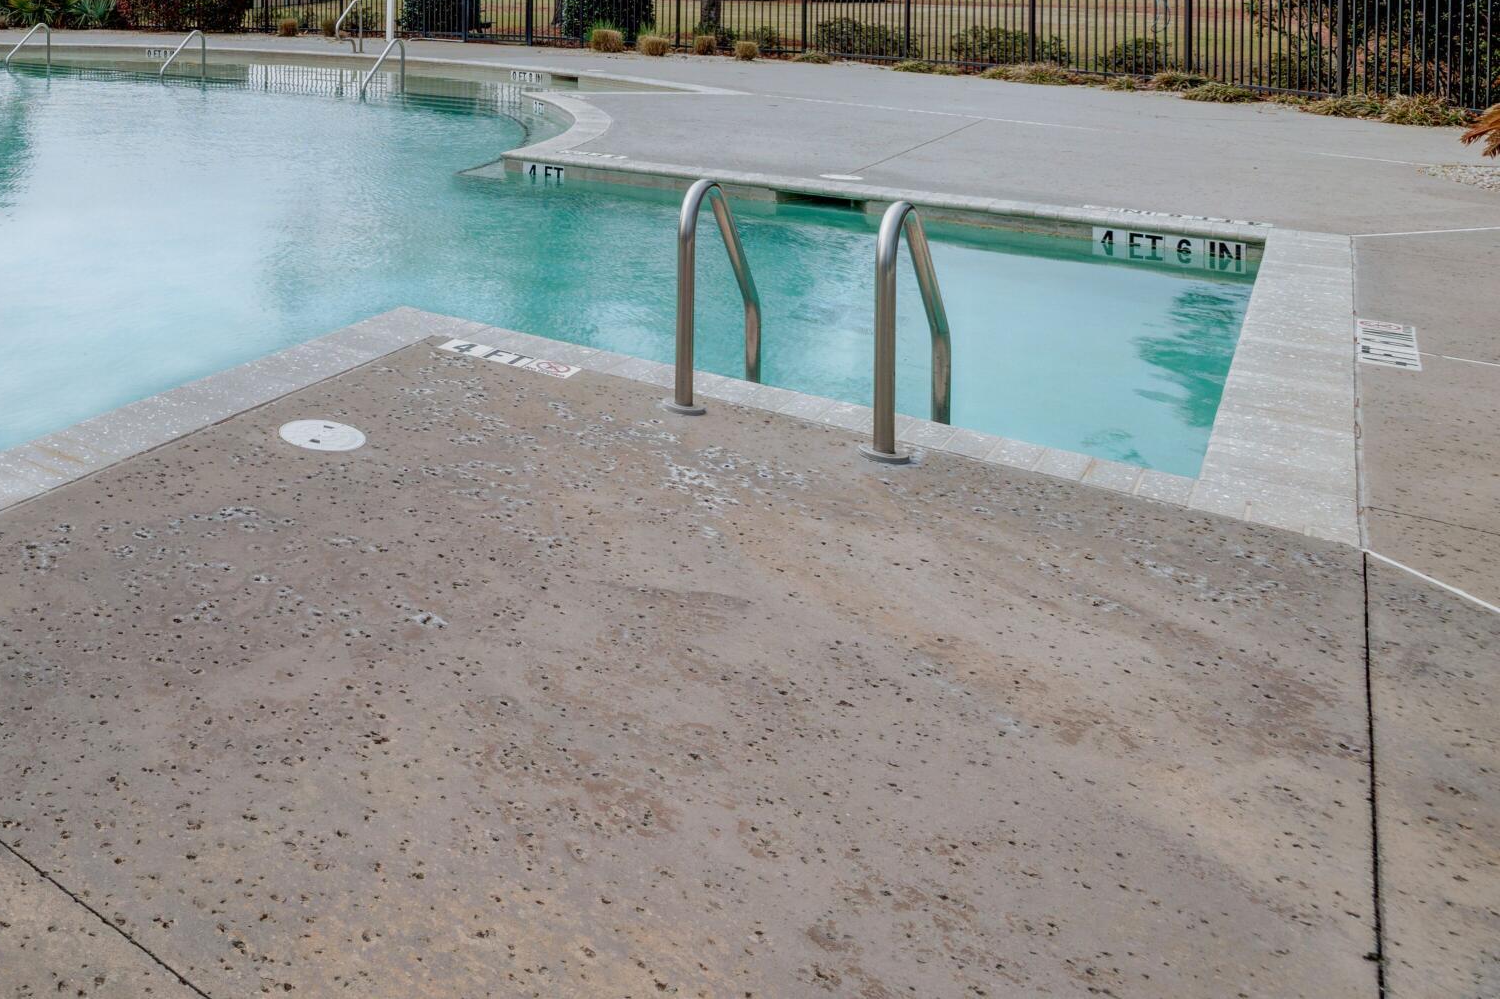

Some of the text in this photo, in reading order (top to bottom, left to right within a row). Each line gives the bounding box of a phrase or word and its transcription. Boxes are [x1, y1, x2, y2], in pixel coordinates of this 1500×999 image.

[544, 165, 564, 180] FT
[1129, 233, 1164, 254] FT
[1209, 241, 1242, 265] IN
[453, 343, 535, 365] 4 FT
